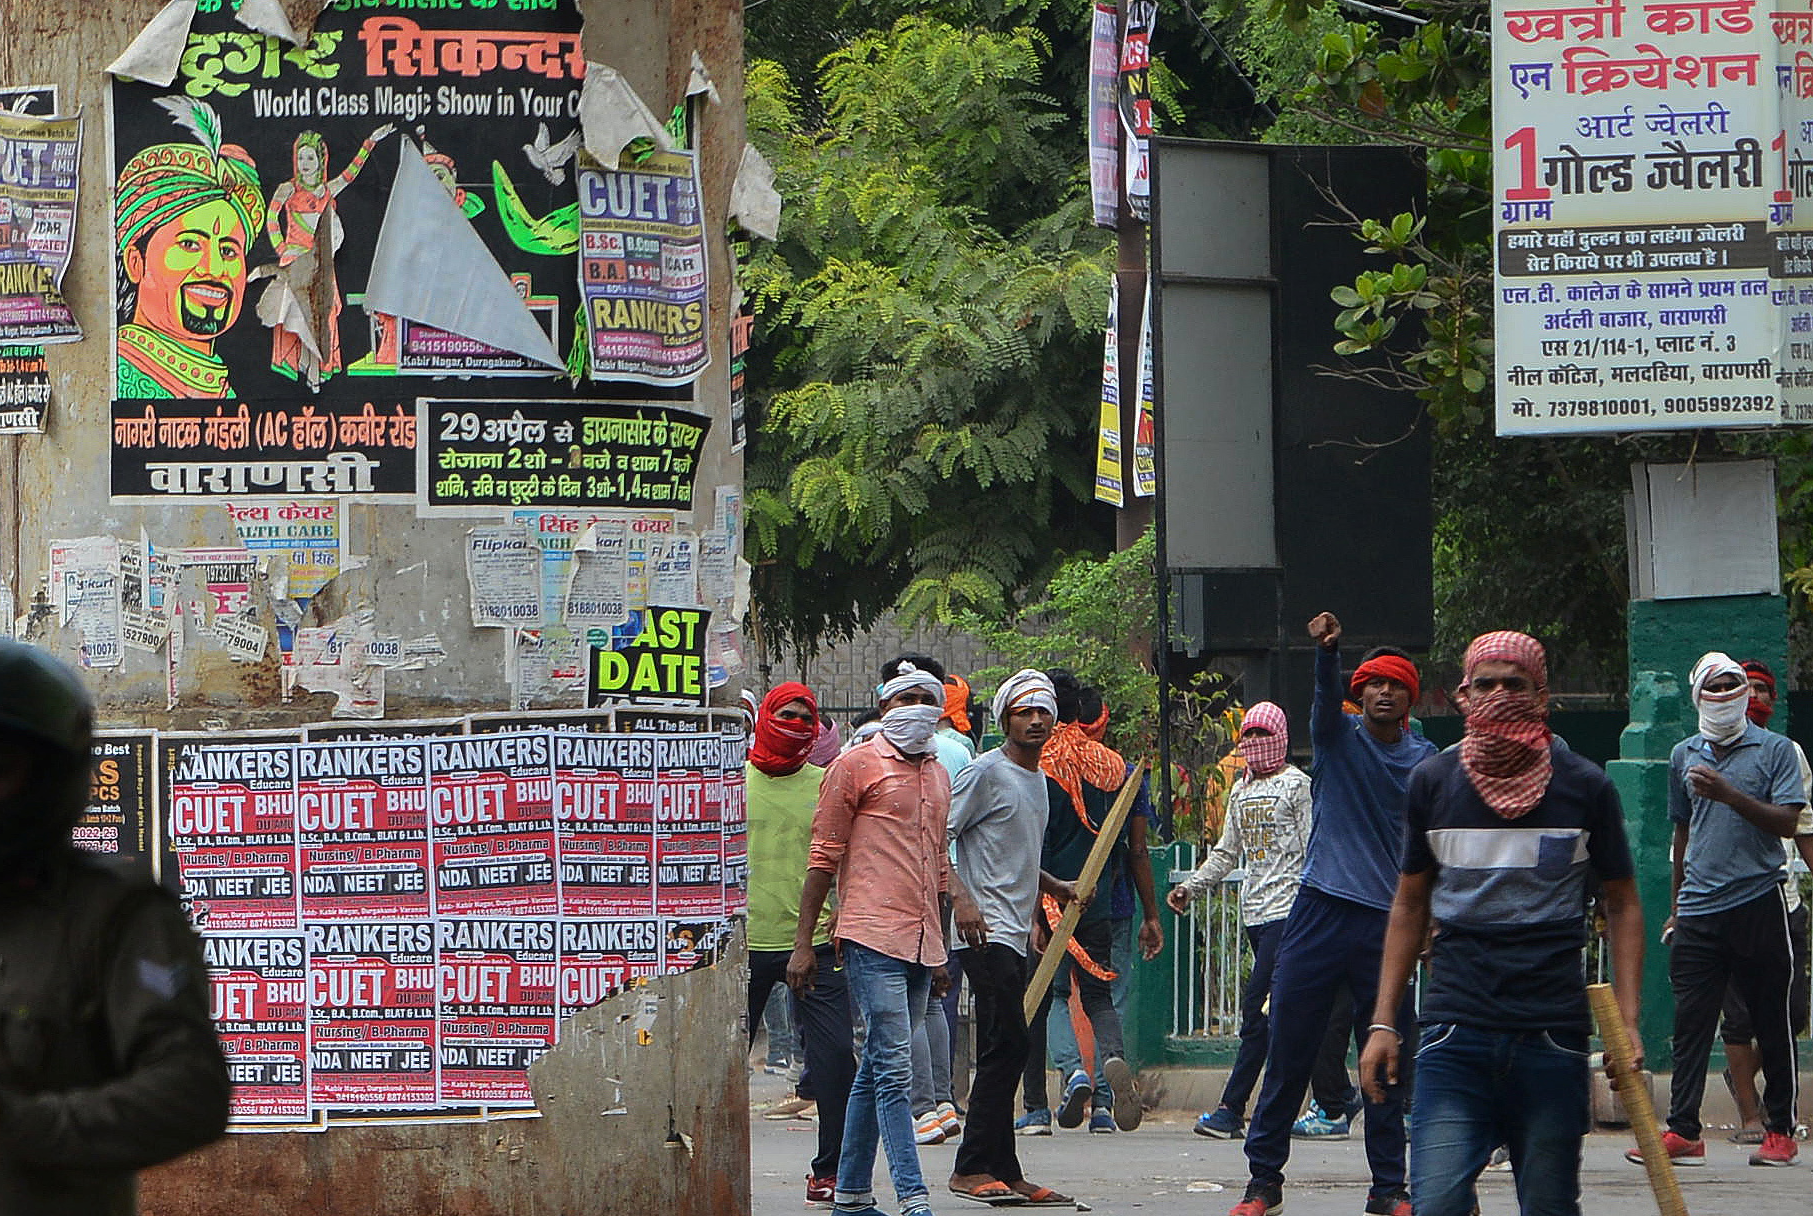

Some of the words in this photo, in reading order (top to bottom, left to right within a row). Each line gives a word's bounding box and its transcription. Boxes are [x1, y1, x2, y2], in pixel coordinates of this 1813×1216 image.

[180, 30, 344, 98] दूगर
[1509, 63, 1553, 100] एन
[1561, 43, 1762, 95] क्रियेशन
[253, 87, 311, 118] World
[317, 86, 369, 117] Class
[374, 85, 431, 122] Magic
[437, 84, 493, 116] Show
[497, 86, 515, 116] in
[519, 86, 563, 116] Your
[1575, 105, 1635, 138] आर्ट
[1644, 101, 1731, 135] ज्वेलरी
[54, 143, 75, 155] BHU
[51, 159, 74, 172] AMU
[1504, 127, 1551, 200] 1
[1542, 144, 1636, 195] गोल्ड
[581, 171, 670, 220] CUET
[1501, 200, 1555, 224] ग्राम
[586, 235, 622, 250] B.Sc.
[626, 236, 660, 253] B.Com
[1507, 231, 1543, 250] हमारे
[1579, 231, 1621, 251] दुल्हन
[1625, 229, 1645, 245] का
[1650, 226, 1693, 245] लहंगा
[1696, 224, 1746, 243] ज्वेलरी
[589, 262, 624, 280] B.A.
[1526, 254, 1550, 273] सेट
[1553, 251, 1600, 271] किराये
[1604, 253, 1622, 270] पर
[1626, 250, 1644, 268] भी
[1649, 250, 1701, 267] उपलब्ध
[1705, 247, 1716, 265] है
[1567, 280, 1621, 302] कालेज
[1625, 280, 1642, 300] के
[1647, 277, 1693, 299] सामने
[1698, 281, 1737, 299] प्रथम
[1740, 279, 1769, 297] तल
[593, 299, 702, 335] RANKERS
[1544, 307, 1594, 330] अर्दली
[1599, 310, 1654, 330] बाजार,
[1659, 304, 1728, 327] वाराणसी
[419, 331, 448, 339] Student
[1542, 339, 1569, 357] एस
[1573, 337, 1649, 359] 21/114-1,
[1656, 335, 1696, 353] प्लाट
[1699, 330, 1720, 353] नं.
[1726, 335, 1736, 352] 3
[403, 356, 430, 367] Kabir
[432, 356, 464, 368] Nagar,
[1506, 364, 1543, 386] नील
[1548, 363, 1605, 387] कॉटेज,
[1610, 361, 1696, 385] मलदहिया,
[1702, 358, 1773, 381] वाराणसी
[1512, 398, 1542, 418] मो.
[1549, 399, 1657, 418] 7379810001,
[1663, 395, 1775, 414] 9005992392
[114, 404, 156, 449] नागरी
[158, 416, 201, 449] नाटक
[203, 404, 251, 450] मंडली
[339, 402, 387, 448] कबीर
[389, 404, 417, 450] रोड
[439, 412, 481, 442] 29
[483, 410, 548, 446] अप्रैल
[552, 421, 575, 443] से
[582, 409, 652, 446] डायनासोर
[654, 411, 668, 447] के
[670, 421, 703, 450] साथ
[438, 447, 504, 470] रोजाना
[507, 448, 523, 470] 2
[524, 446, 547, 470] शो
[582, 448, 611, 471] बजे
[616, 456, 629, 470] व
[631, 455, 660, 471] शाम
[661, 449, 672, 470] 7
[145, 451, 381, 494] वाराणसी
[237, 525, 279, 538] ALTH
[288, 525, 333, 538] CARE
[539, 514, 579, 533] सिंह
[631, 516, 673, 533] केयर
[631, 610, 700, 650] AST
[598, 651, 701, 695] DATE
[635, 719, 656, 730] ALL
[658, 719, 677, 731] The
[679, 720, 697, 732] Best
[104, 744, 130, 755] Best
[301, 747, 422, 777] RANKERS
[432, 737, 548, 771] RANKERS
[557, 738, 652, 767] RANKERS
[658, 739, 721, 768] RANKERS
[381, 776, 424, 785] Educare
[300, 792, 377, 831] CUET
[387, 790, 427, 812] BHU
[309, 849, 362, 862] Nursing/
[364, 848, 422, 860] B.Pharma
[303, 876, 336, 894] NDA
[344, 874, 386, 892] NEET
[394, 873, 424, 891] JEE
[439, 921, 553, 950] RANKERS
[439, 965, 512, 1003] CUET
[519, 966, 555, 987] BHU
[443, 1021, 495, 1037] Nursing/
